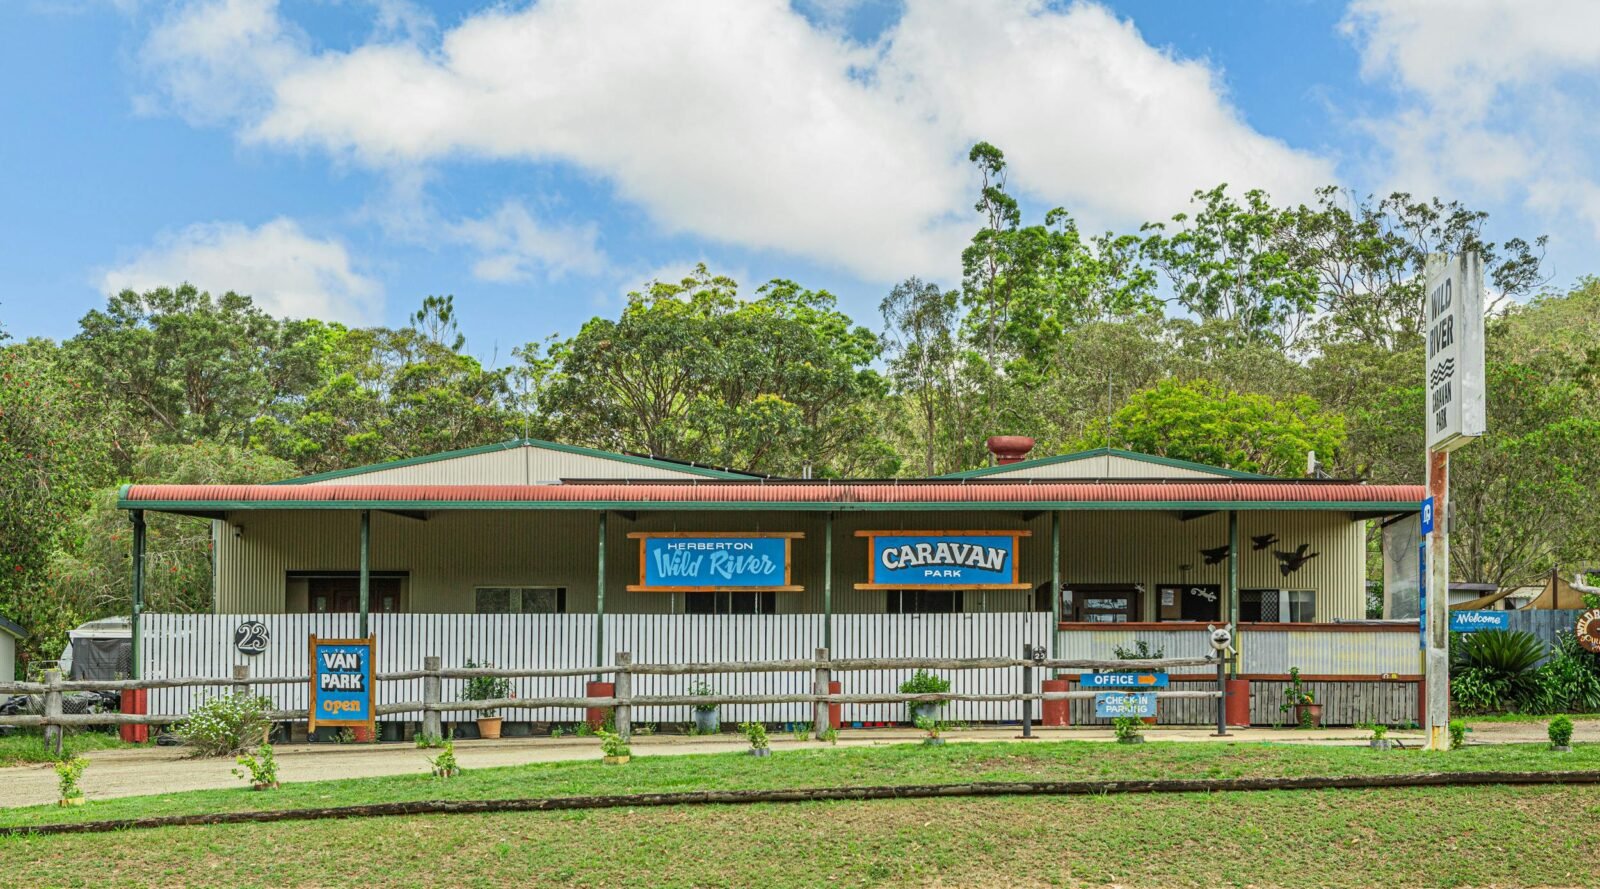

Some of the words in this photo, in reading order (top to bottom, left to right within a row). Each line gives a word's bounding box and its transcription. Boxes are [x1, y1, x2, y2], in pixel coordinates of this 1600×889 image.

[1431, 278, 1452, 322] WILD
[1430, 314, 1454, 360] RIVER
[1436, 407, 1447, 434] PARK
[667, 542, 753, 550] HERBERTON
[881, 541, 1007, 571] CARAVAN
[653, 547, 704, 578] Wild
[709, 549, 776, 580] River
[924, 569, 962, 578] PARK
[1456, 612, 1502, 625] Welcome
[238, 623, 268, 651] 23
[322, 652, 360, 671] VAN
[321, 673, 365, 691] PARK
[1094, 675, 1134, 685] OFFICE
